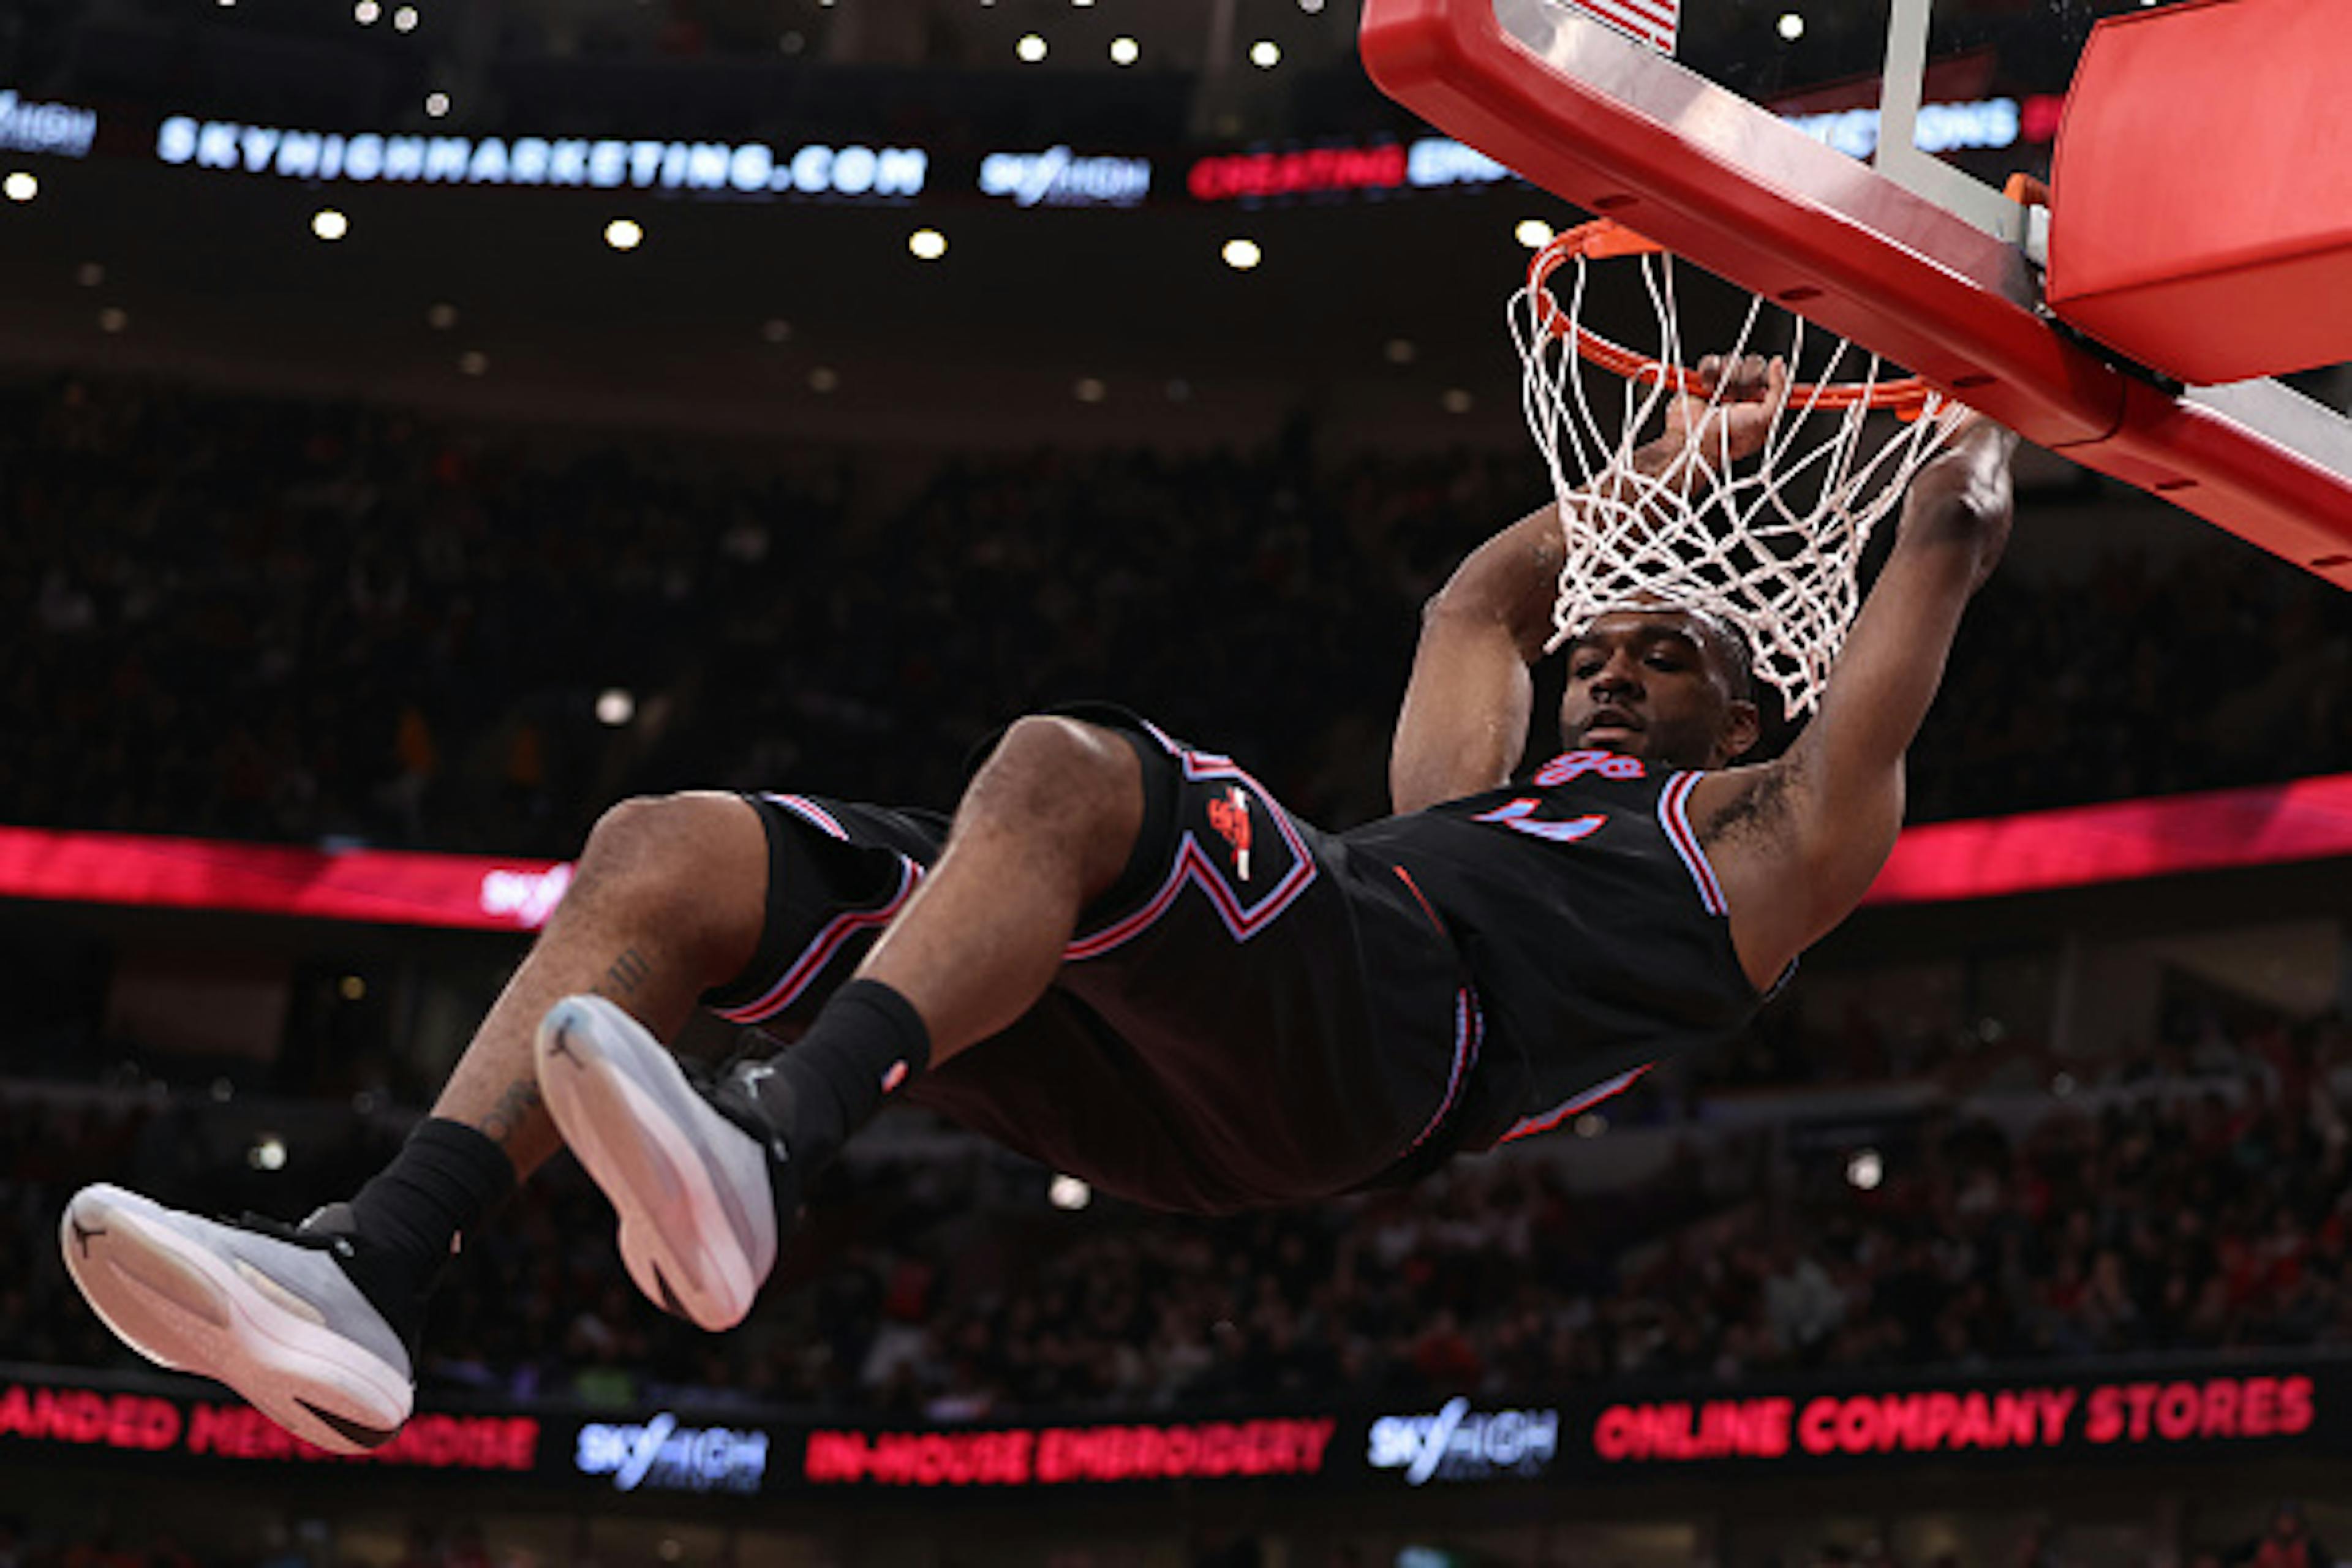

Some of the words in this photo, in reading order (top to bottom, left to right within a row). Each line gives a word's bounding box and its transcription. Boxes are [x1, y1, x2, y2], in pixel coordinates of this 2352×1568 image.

[157, 115, 928, 196] SKYHIGHMARKETING.COM
[1594, 1399, 1794, 1459] ONLINE
[1797, 1388, 2076, 1454] COMPANY
[2084, 1375, 2313, 1443] STORES
